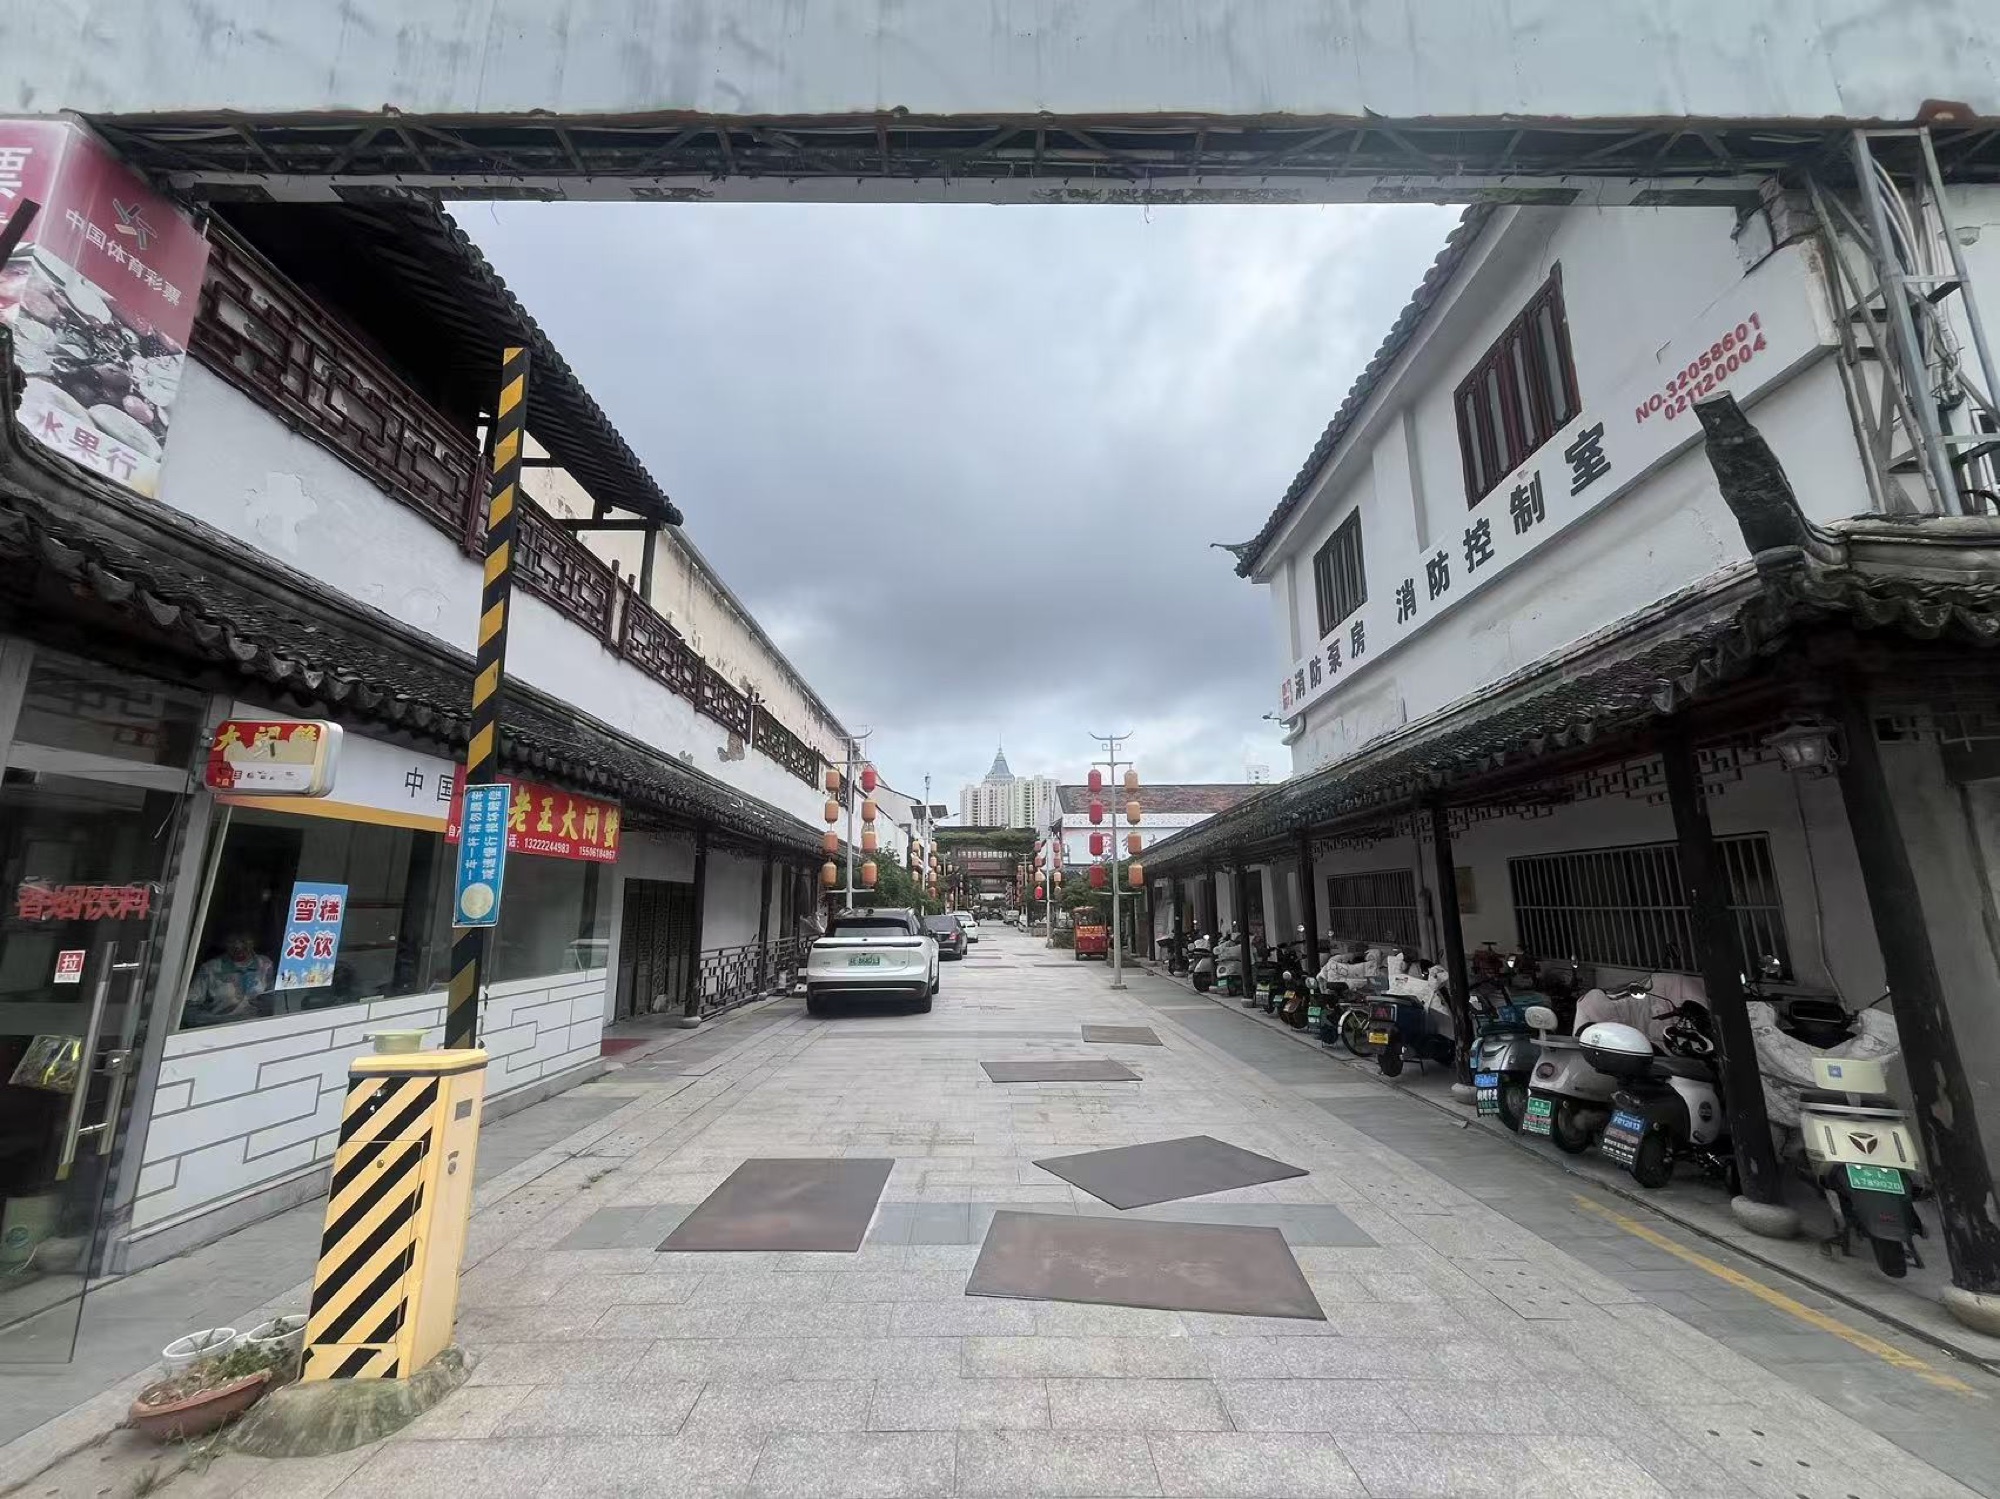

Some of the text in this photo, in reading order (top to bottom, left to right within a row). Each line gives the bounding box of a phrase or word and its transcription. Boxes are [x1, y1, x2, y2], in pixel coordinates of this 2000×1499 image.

[65, 208, 181, 306] 中国体育彩票
[1635, 311, 1761, 424] NO.32058601
[38, 411, 138, 480] 水果行
[1395, 421, 1612, 625] 消防控制室
[404, 766, 455, 802] 中国
[507, 784, 619, 849] 老王大闸蟹
[14, 884, 151, 921] 香烟饮料
[294, 895, 342, 922] 雪糕
[286, 931, 336, 960] 冷饮
